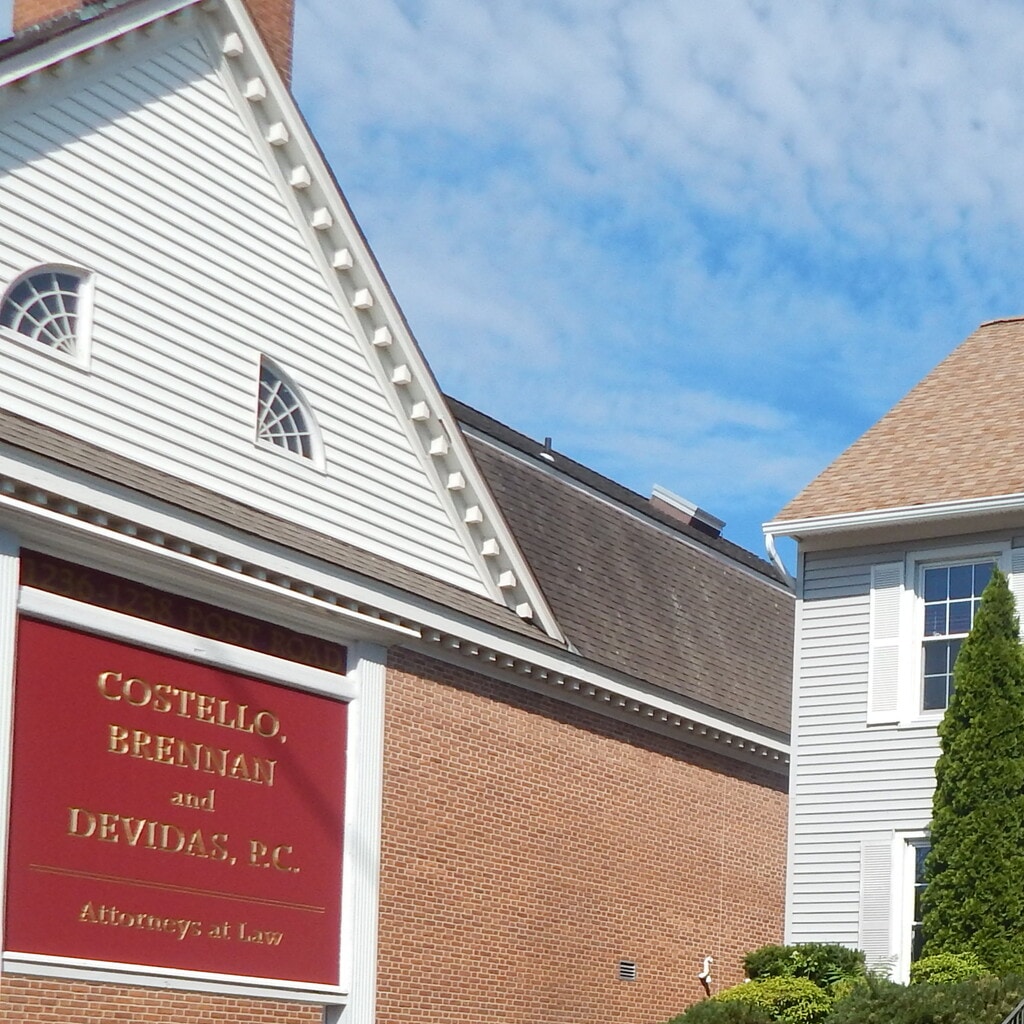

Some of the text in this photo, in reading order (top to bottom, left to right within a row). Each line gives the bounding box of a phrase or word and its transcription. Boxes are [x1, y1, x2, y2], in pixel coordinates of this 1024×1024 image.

[187, 605, 261, 645] POST
[272, 629, 343, 671] ROAD
[98, 671, 287, 744] COSTELLO,
[108, 724, 277, 787] BRENNAN
[170, 789, 216, 813] and
[67, 807, 301, 873] DEVIDAS, P.C.
[78, 901, 284, 946] Attorneys at Law
